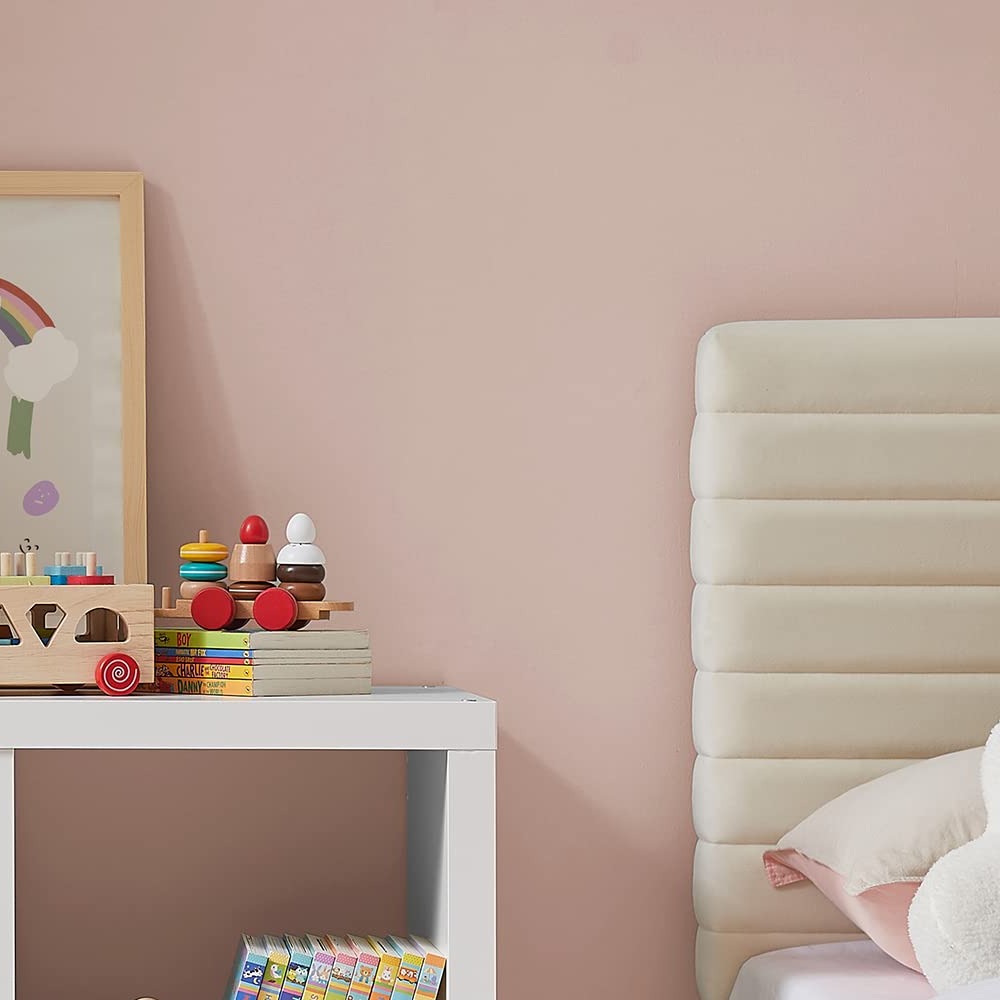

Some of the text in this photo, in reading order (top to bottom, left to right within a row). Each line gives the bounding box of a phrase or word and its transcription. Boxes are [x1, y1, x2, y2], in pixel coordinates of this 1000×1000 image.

[176, 632, 191, 647] BOY
[176, 663, 204, 676] CHARLIE
[178, 680, 203, 694] DANNY
